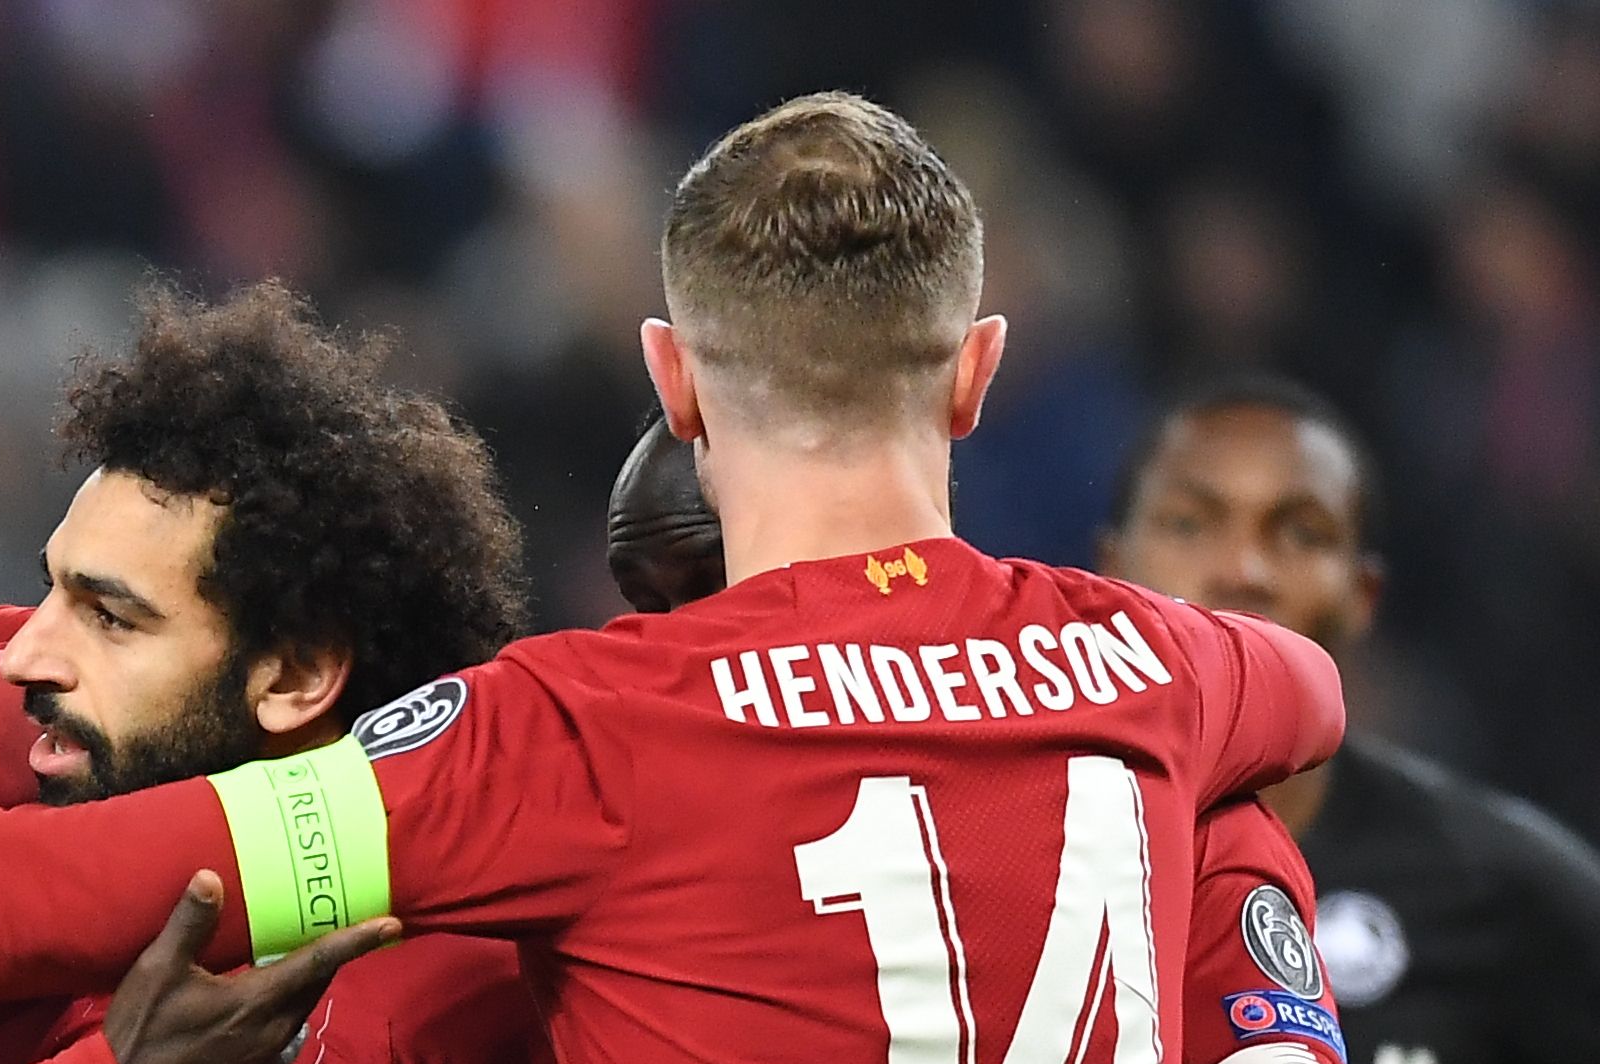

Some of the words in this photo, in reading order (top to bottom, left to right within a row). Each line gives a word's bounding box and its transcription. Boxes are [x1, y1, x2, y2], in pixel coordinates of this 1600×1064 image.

[710, 610, 1173, 729] HENDERSON
[288, 792, 339, 930] RESPECT
[1282, 940, 1303, 969] 6
